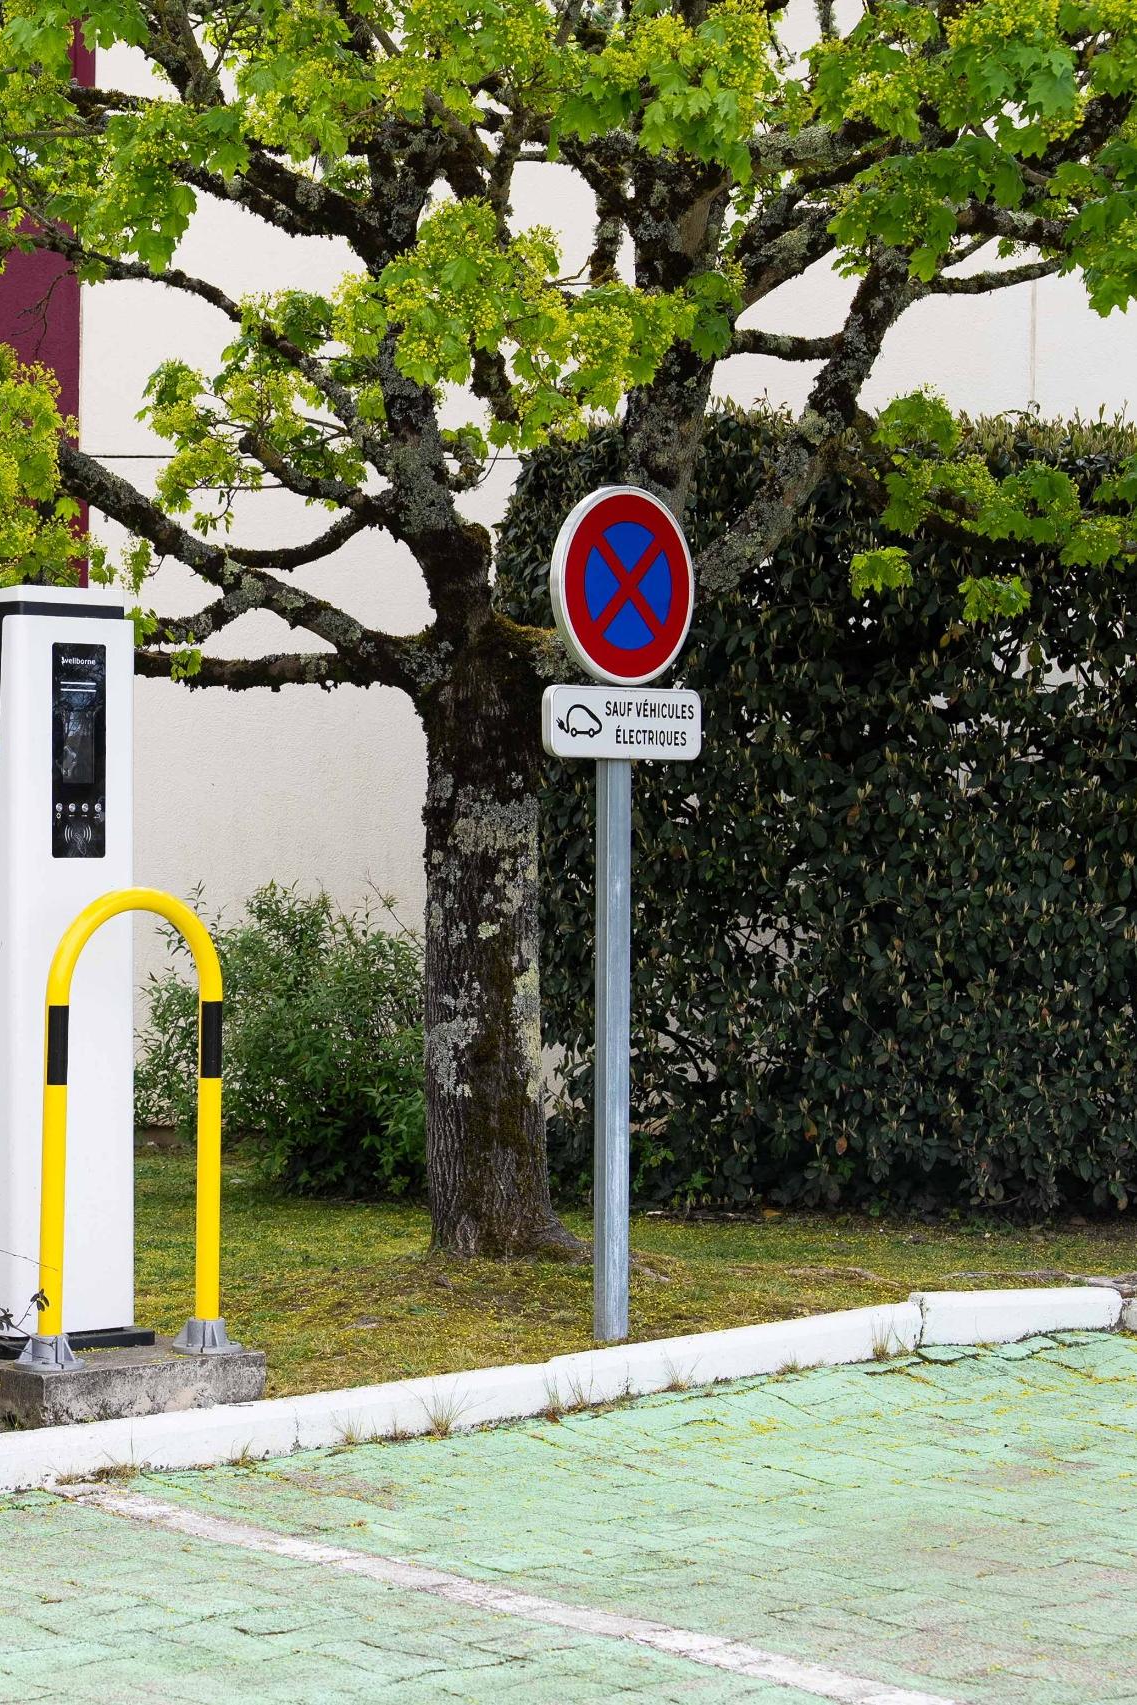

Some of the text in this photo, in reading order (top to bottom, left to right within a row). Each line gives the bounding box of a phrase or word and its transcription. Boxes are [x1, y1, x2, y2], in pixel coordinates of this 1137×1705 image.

[605, 699, 695, 720] SAUF VÉHICULES
[615, 725, 687, 747] ÉLECTRIQUES
